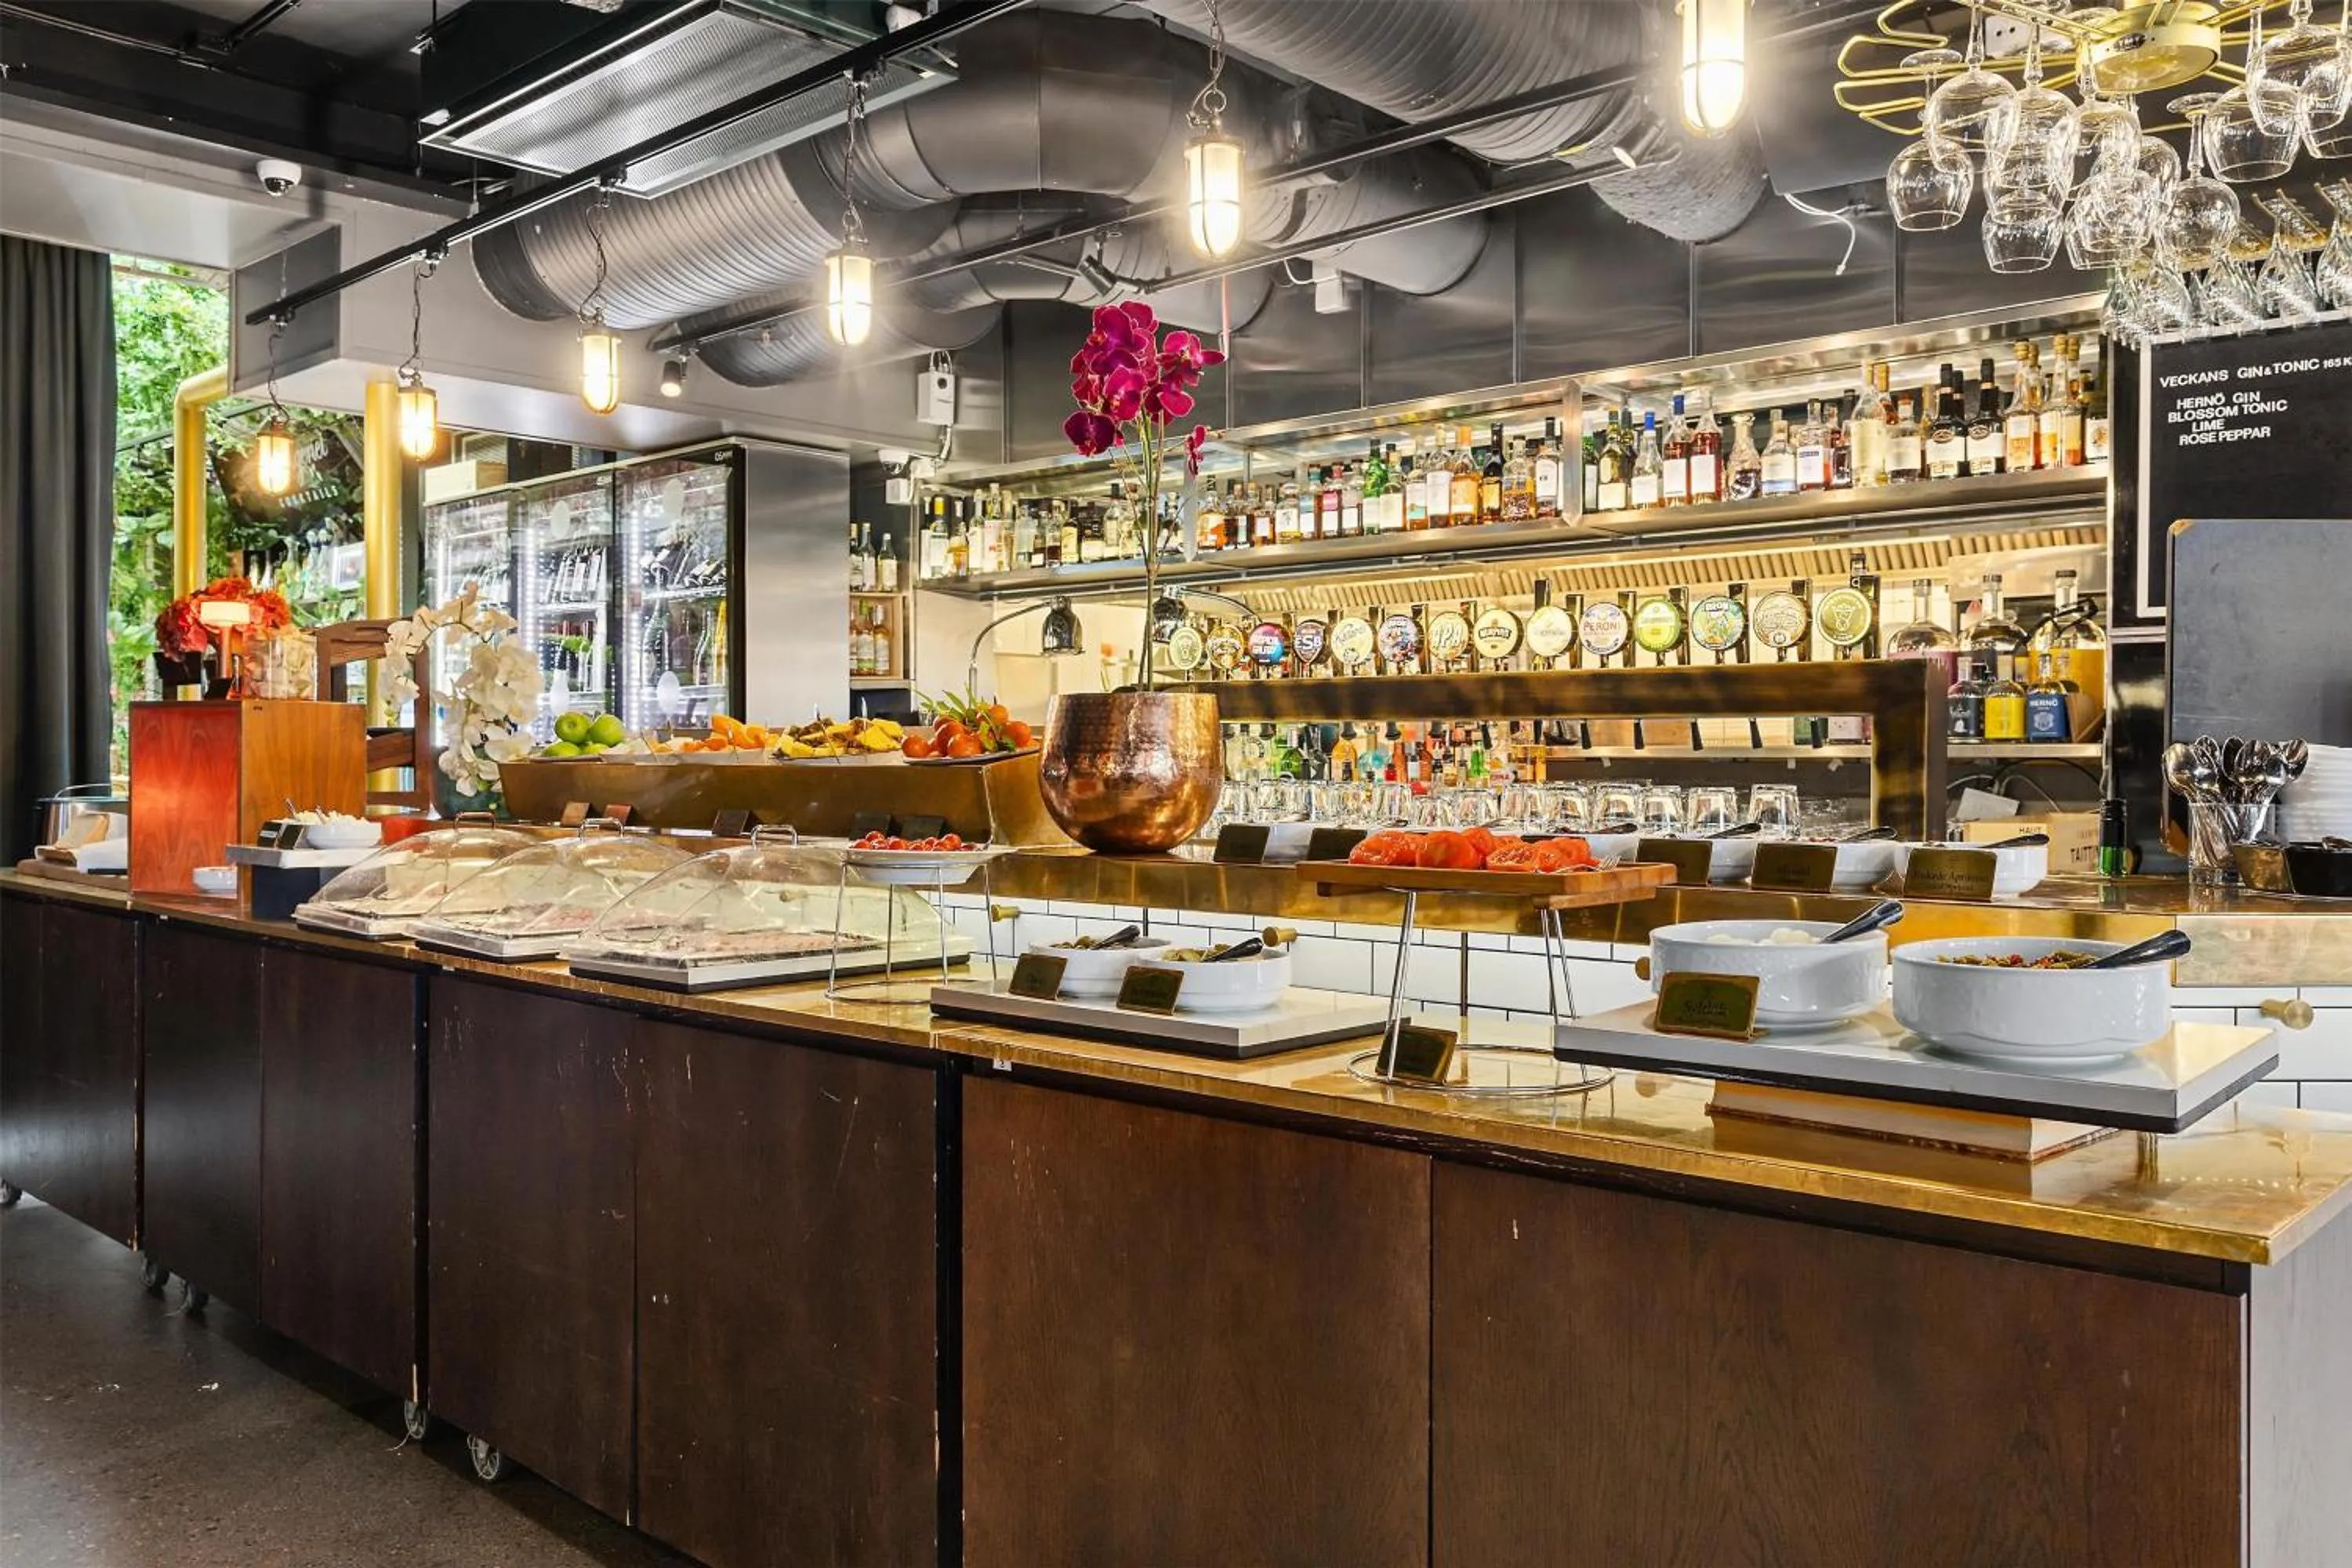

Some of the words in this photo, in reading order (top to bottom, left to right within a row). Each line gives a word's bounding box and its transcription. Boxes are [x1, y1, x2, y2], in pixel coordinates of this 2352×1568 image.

[2159, 370, 2229, 387] VECKANS
[2176, 392, 2226, 409] HERNÖ
[2233, 390, 2260, 404] GIN
[2168, 406, 2238, 423] BLOSSOM
[2242, 400, 2288, 415] TONIC
[2192, 419, 2226, 433] LIME
